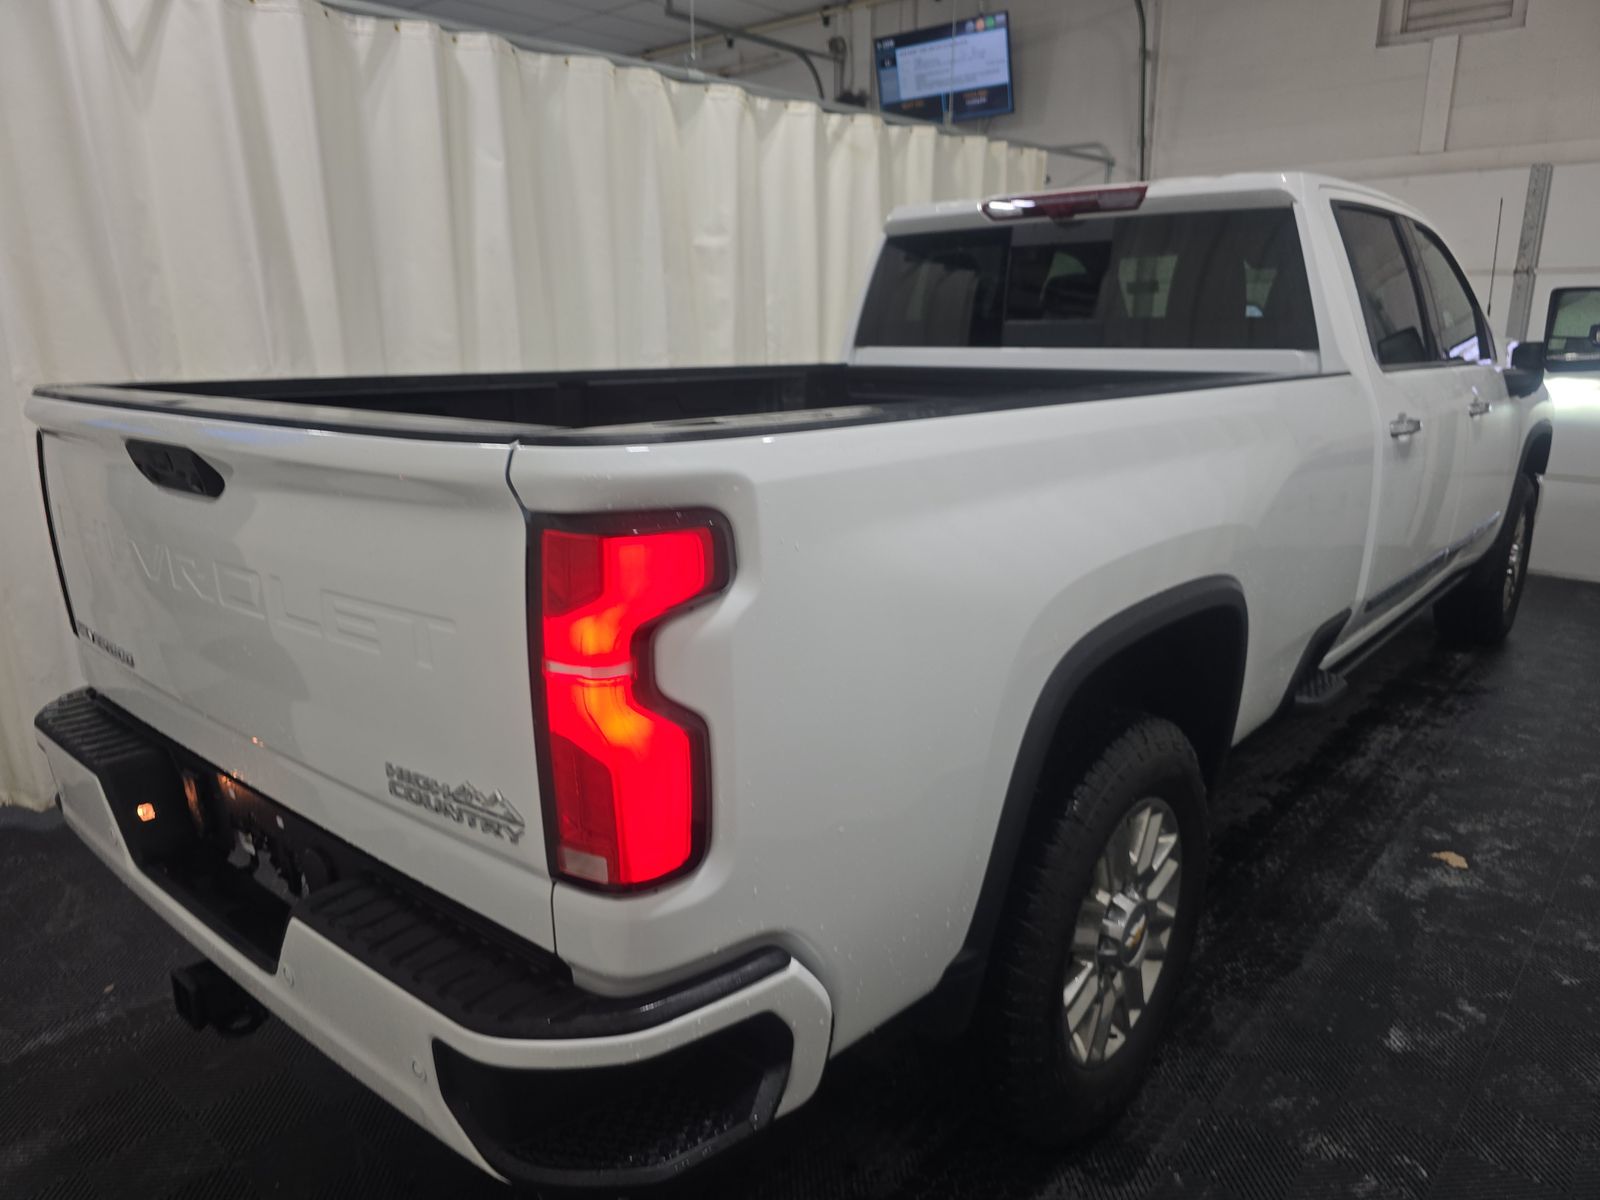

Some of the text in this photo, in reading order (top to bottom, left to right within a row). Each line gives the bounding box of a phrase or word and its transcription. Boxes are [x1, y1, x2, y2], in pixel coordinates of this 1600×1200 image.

[57, 506, 456, 670] VROLET
[385, 760, 451, 798] HIGH
[389, 780, 525, 846] COUNTRY
